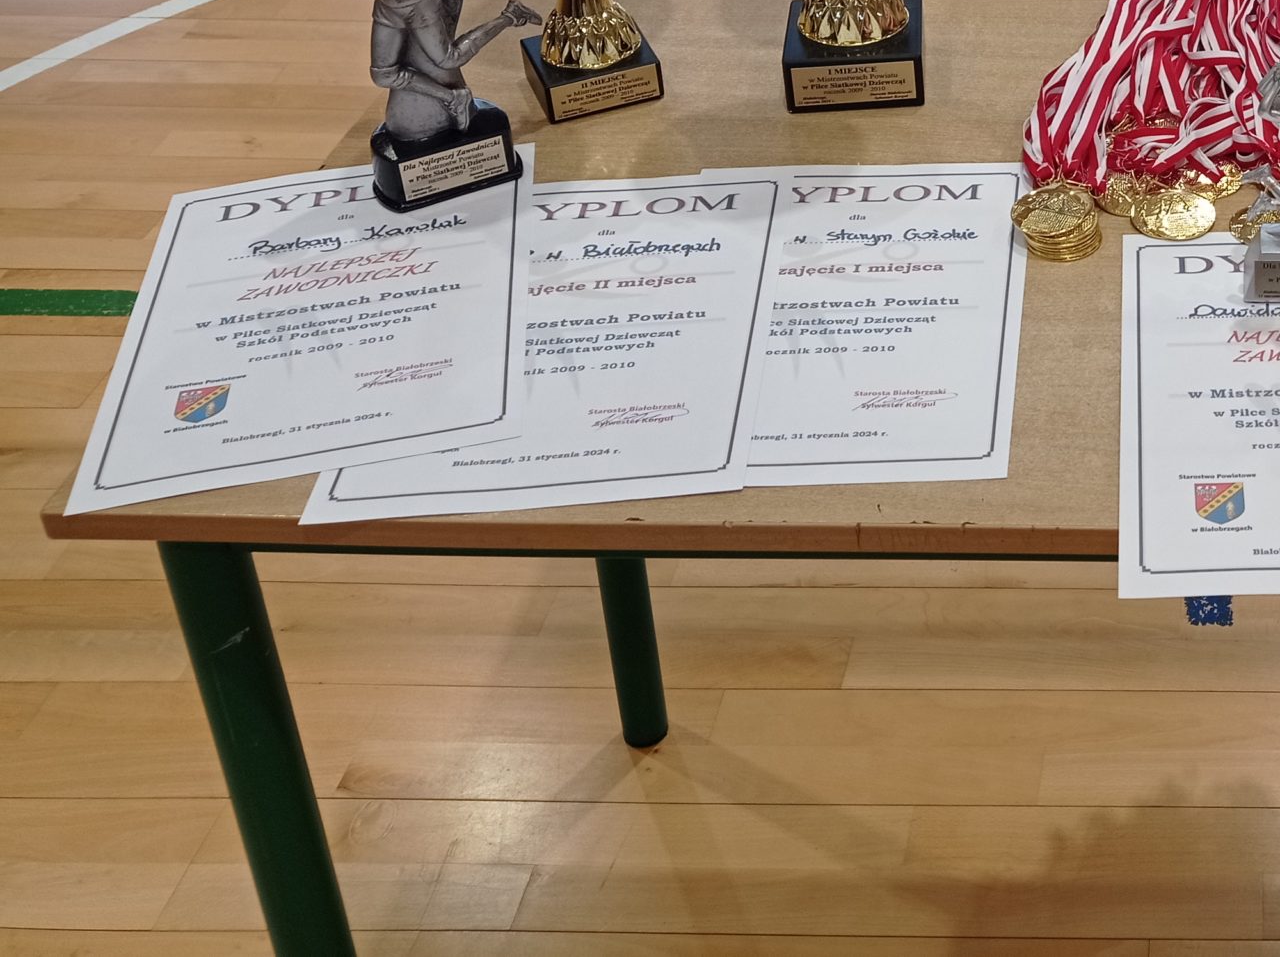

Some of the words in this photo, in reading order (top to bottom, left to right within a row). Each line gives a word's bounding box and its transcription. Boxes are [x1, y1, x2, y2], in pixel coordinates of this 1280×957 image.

[834, 66, 877, 75] MIEJSCE
[792, 183, 984, 204] YPLOM
[216, 185, 376, 223] DYPL
[532, 193, 741, 221] YPLOM
[849, 213, 866, 221] dla
[262, 247, 422, 281] NAJLEPSZEJ
[778, 264, 846, 277] zajęcie
[852, 264, 862, 273] I
[867, 262, 944, 274] miejsca
[237, 261, 439, 302] ZAWODNICZKI
[593, 280, 612, 290] II
[616, 275, 697, 292] miejsca
[196, 321, 211, 329] w
[219, 295, 370, 326] Mistrzostwach
[378, 283, 461, 302] Powiatu
[773, 298, 876, 310] trzostwach
[883, 296, 959, 307] Powiatu
[276, 314, 354, 334] Siatkowej
[358, 302, 438, 320] Dziewcząt
[526, 314, 619, 330] zostwach
[628, 310, 707, 323] Powiatu
[787, 316, 860, 327] Siatkowej
[863, 315, 936, 326] Dziewcząt
[289, 316, 412, 341] Podstawowych
[769, 328, 794, 337] kół
[799, 325, 913, 337] Podstawowych
[525, 334, 600, 347] Siatkowej
[604, 329, 682, 342] Dziewcząt
[248, 348, 303, 363] rocznik
[307, 342, 343, 354] 2009
[359, 334, 395, 346] 2010
[535, 340, 656, 357] Podstawowych
[765, 347, 811, 356] ocznik
[815, 346, 848, 354] 2009
[862, 345, 896, 353] 2010
[550, 364, 586, 374] 2009
[600, 361, 636, 370] 2010
[1188, 391, 1203, 399] w
[289, 424, 302, 433] 31
[305, 417, 351, 433] stycznia
[354, 412, 382, 422] 2024
